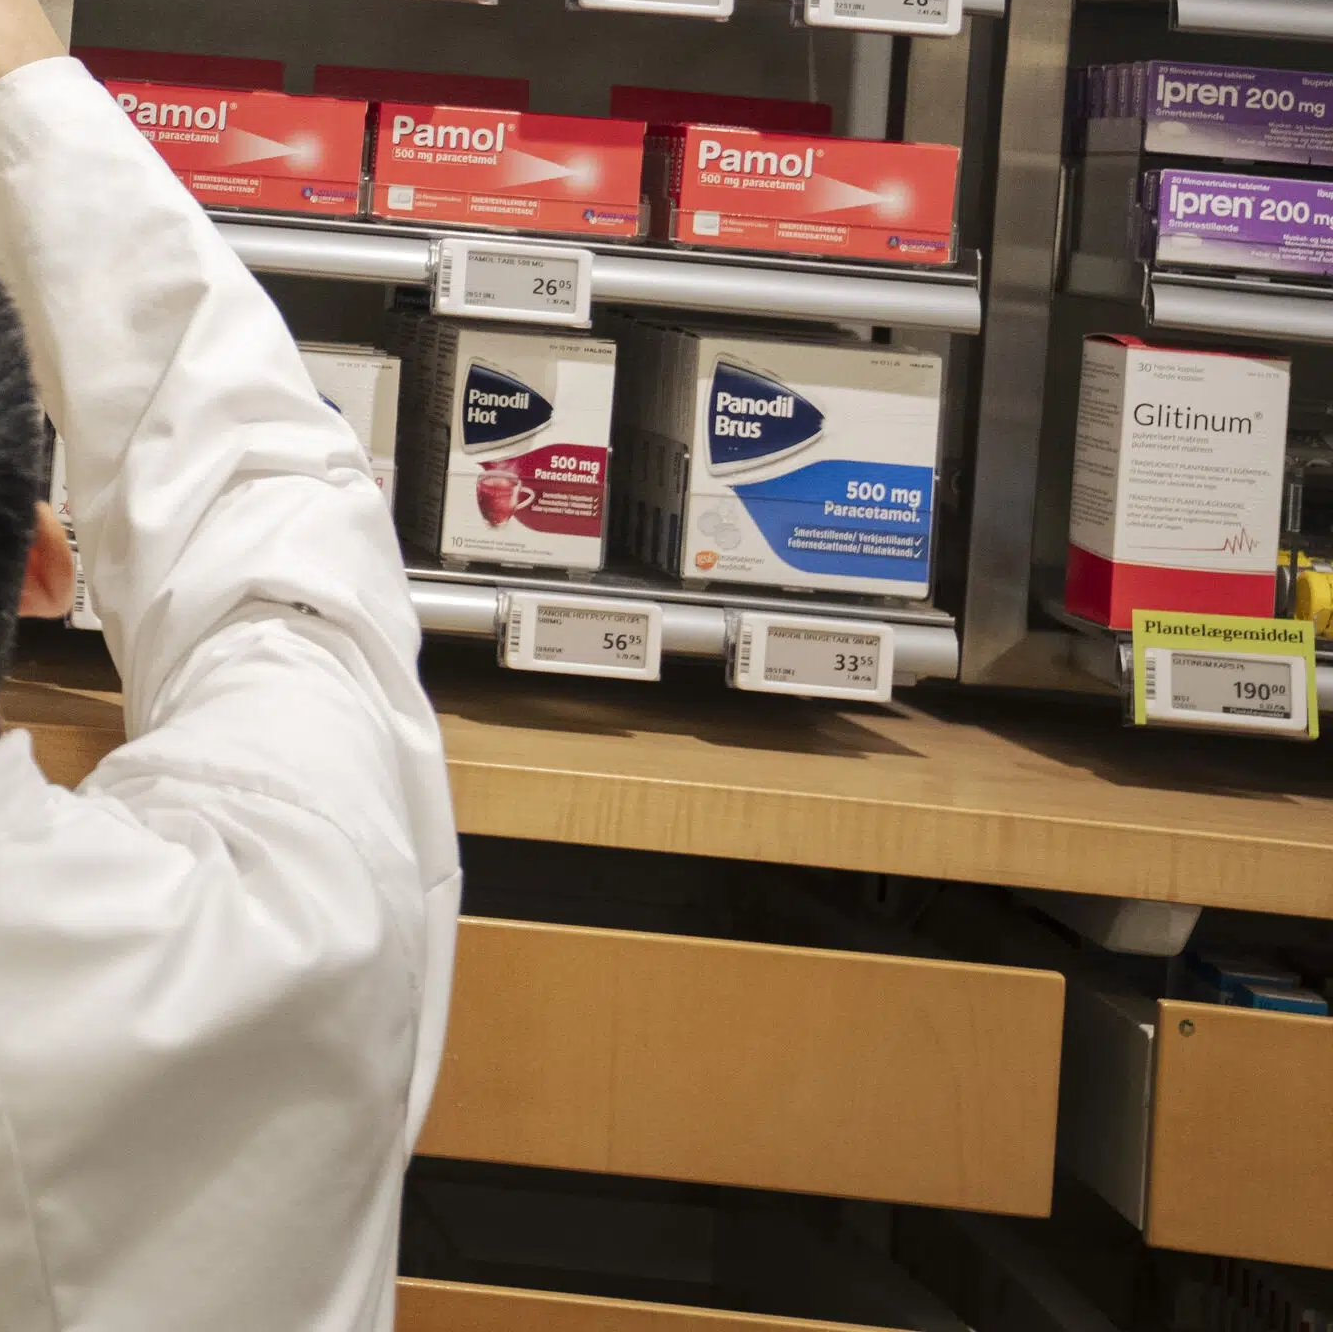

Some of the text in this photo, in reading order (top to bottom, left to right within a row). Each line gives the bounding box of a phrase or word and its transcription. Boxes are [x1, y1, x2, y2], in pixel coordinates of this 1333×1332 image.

[1157, 74, 1325, 117] Ipren 200 mg
[1169, 185, 1251, 218] Ipren
[469, 389, 529, 410] Panodil
[716, 393, 793, 417] Panodil
[467, 406, 497, 425] Hot
[714, 417, 761, 439] Brus
[1145, 621, 1303, 644] Plantelægemiddel
